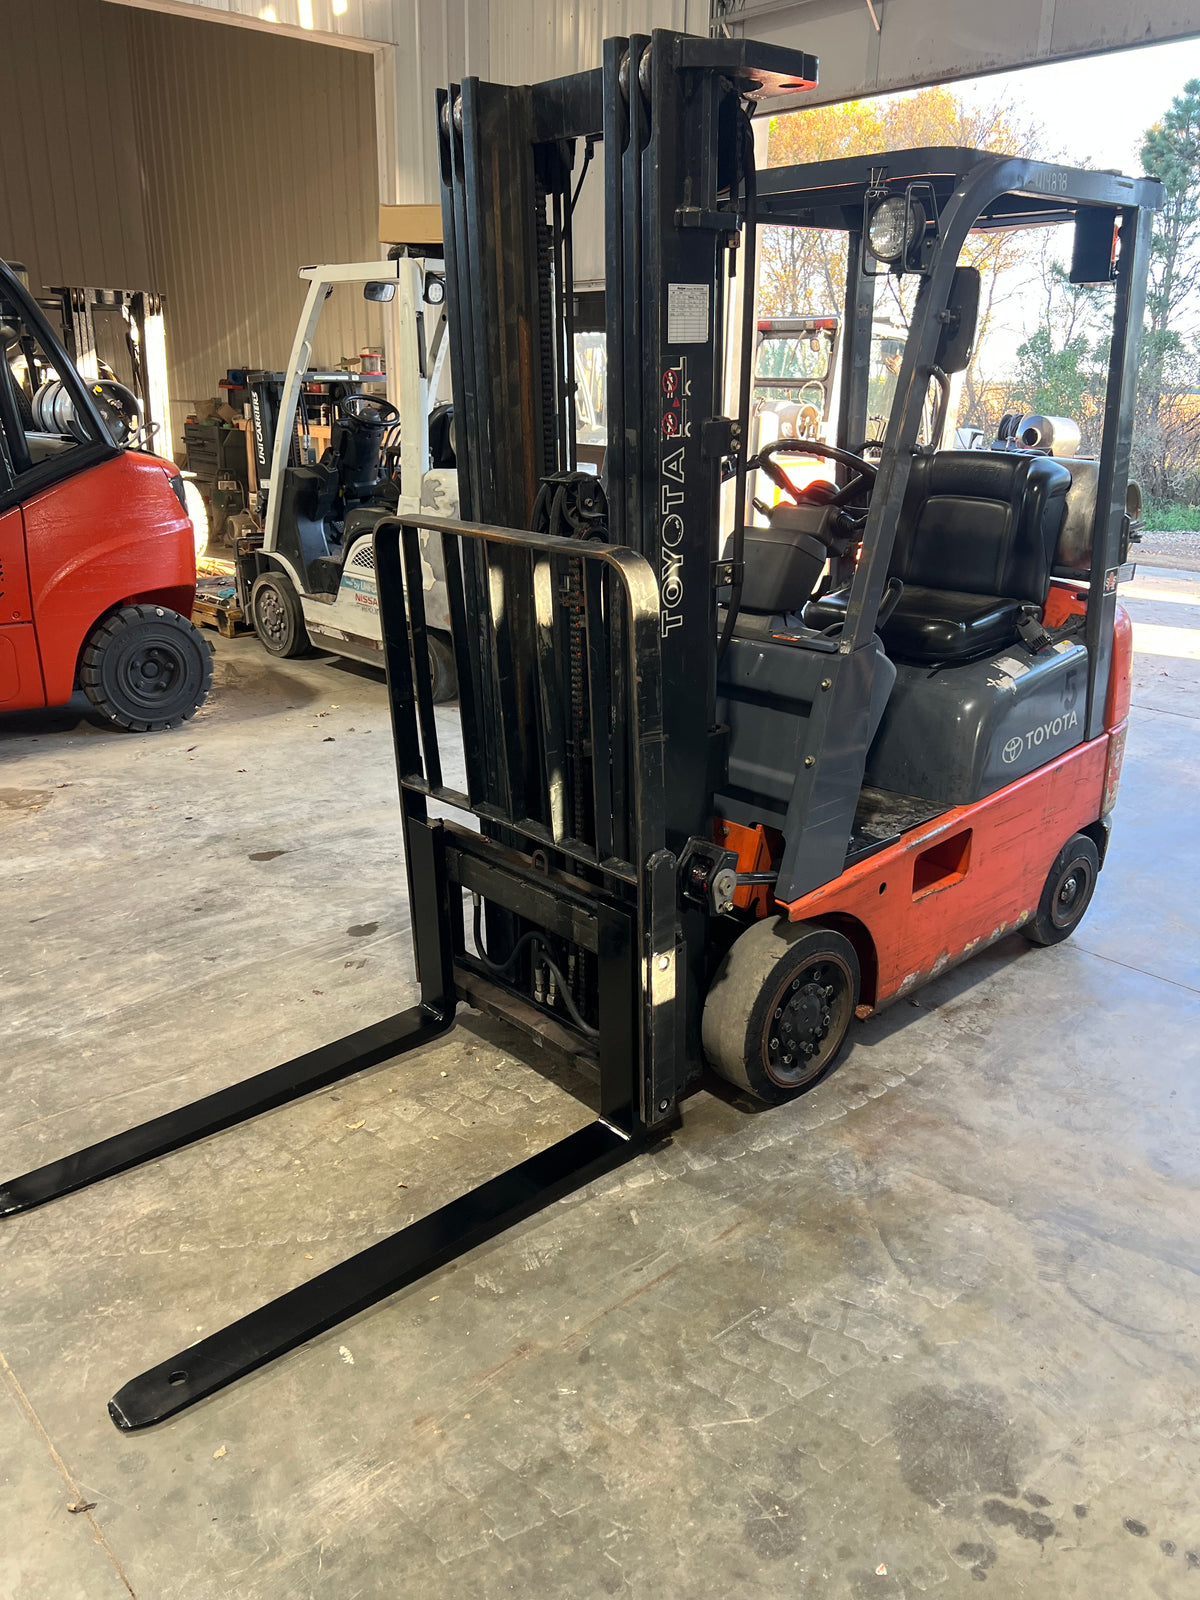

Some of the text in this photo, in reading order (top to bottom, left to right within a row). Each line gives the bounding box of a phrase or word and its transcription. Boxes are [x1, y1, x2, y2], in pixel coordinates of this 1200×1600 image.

[251, 390, 266, 465] UNICARRIERS
[661, 446, 685, 638] TOYOTA
[355, 593, 379, 607] NISSA
[1025, 710, 1078, 750] TOYOTA
